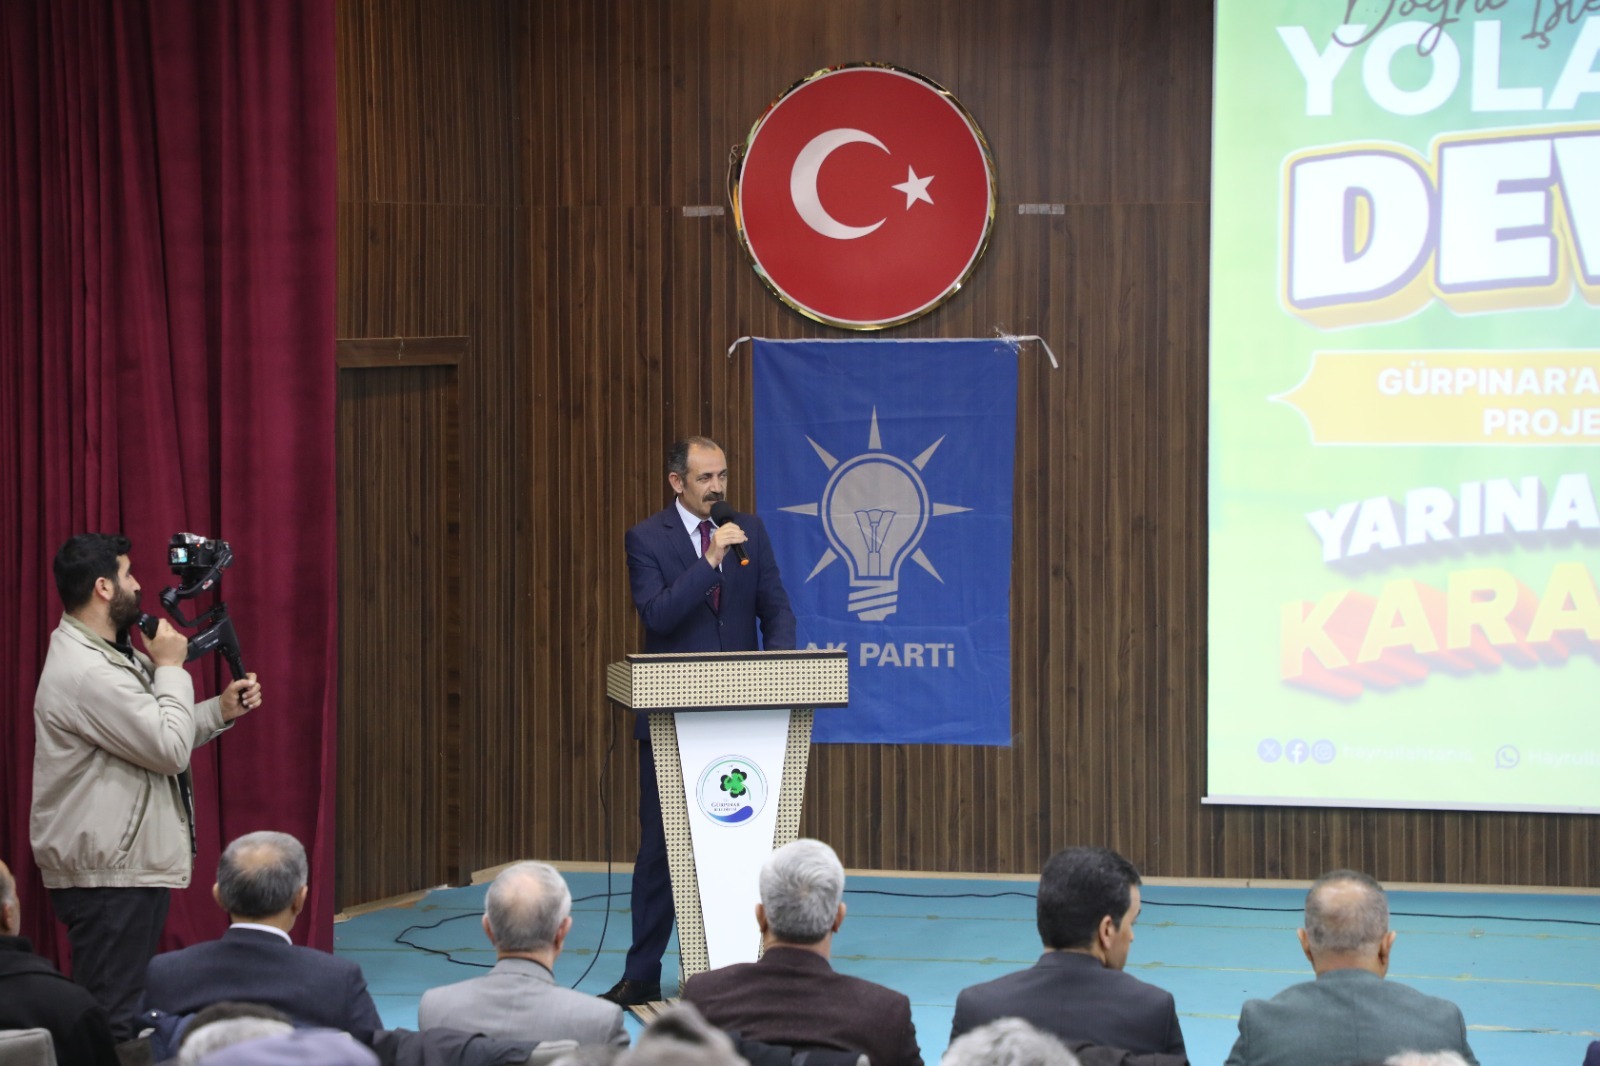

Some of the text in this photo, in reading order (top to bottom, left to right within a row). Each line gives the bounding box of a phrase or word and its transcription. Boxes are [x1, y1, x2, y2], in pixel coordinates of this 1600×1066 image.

[1377, 360, 1600, 395] GÜRPINAR'A
[1483, 407, 1600, 436] PROJE
[1304, 472, 1600, 563] YARINA
[1280, 561, 1600, 682] KARA
